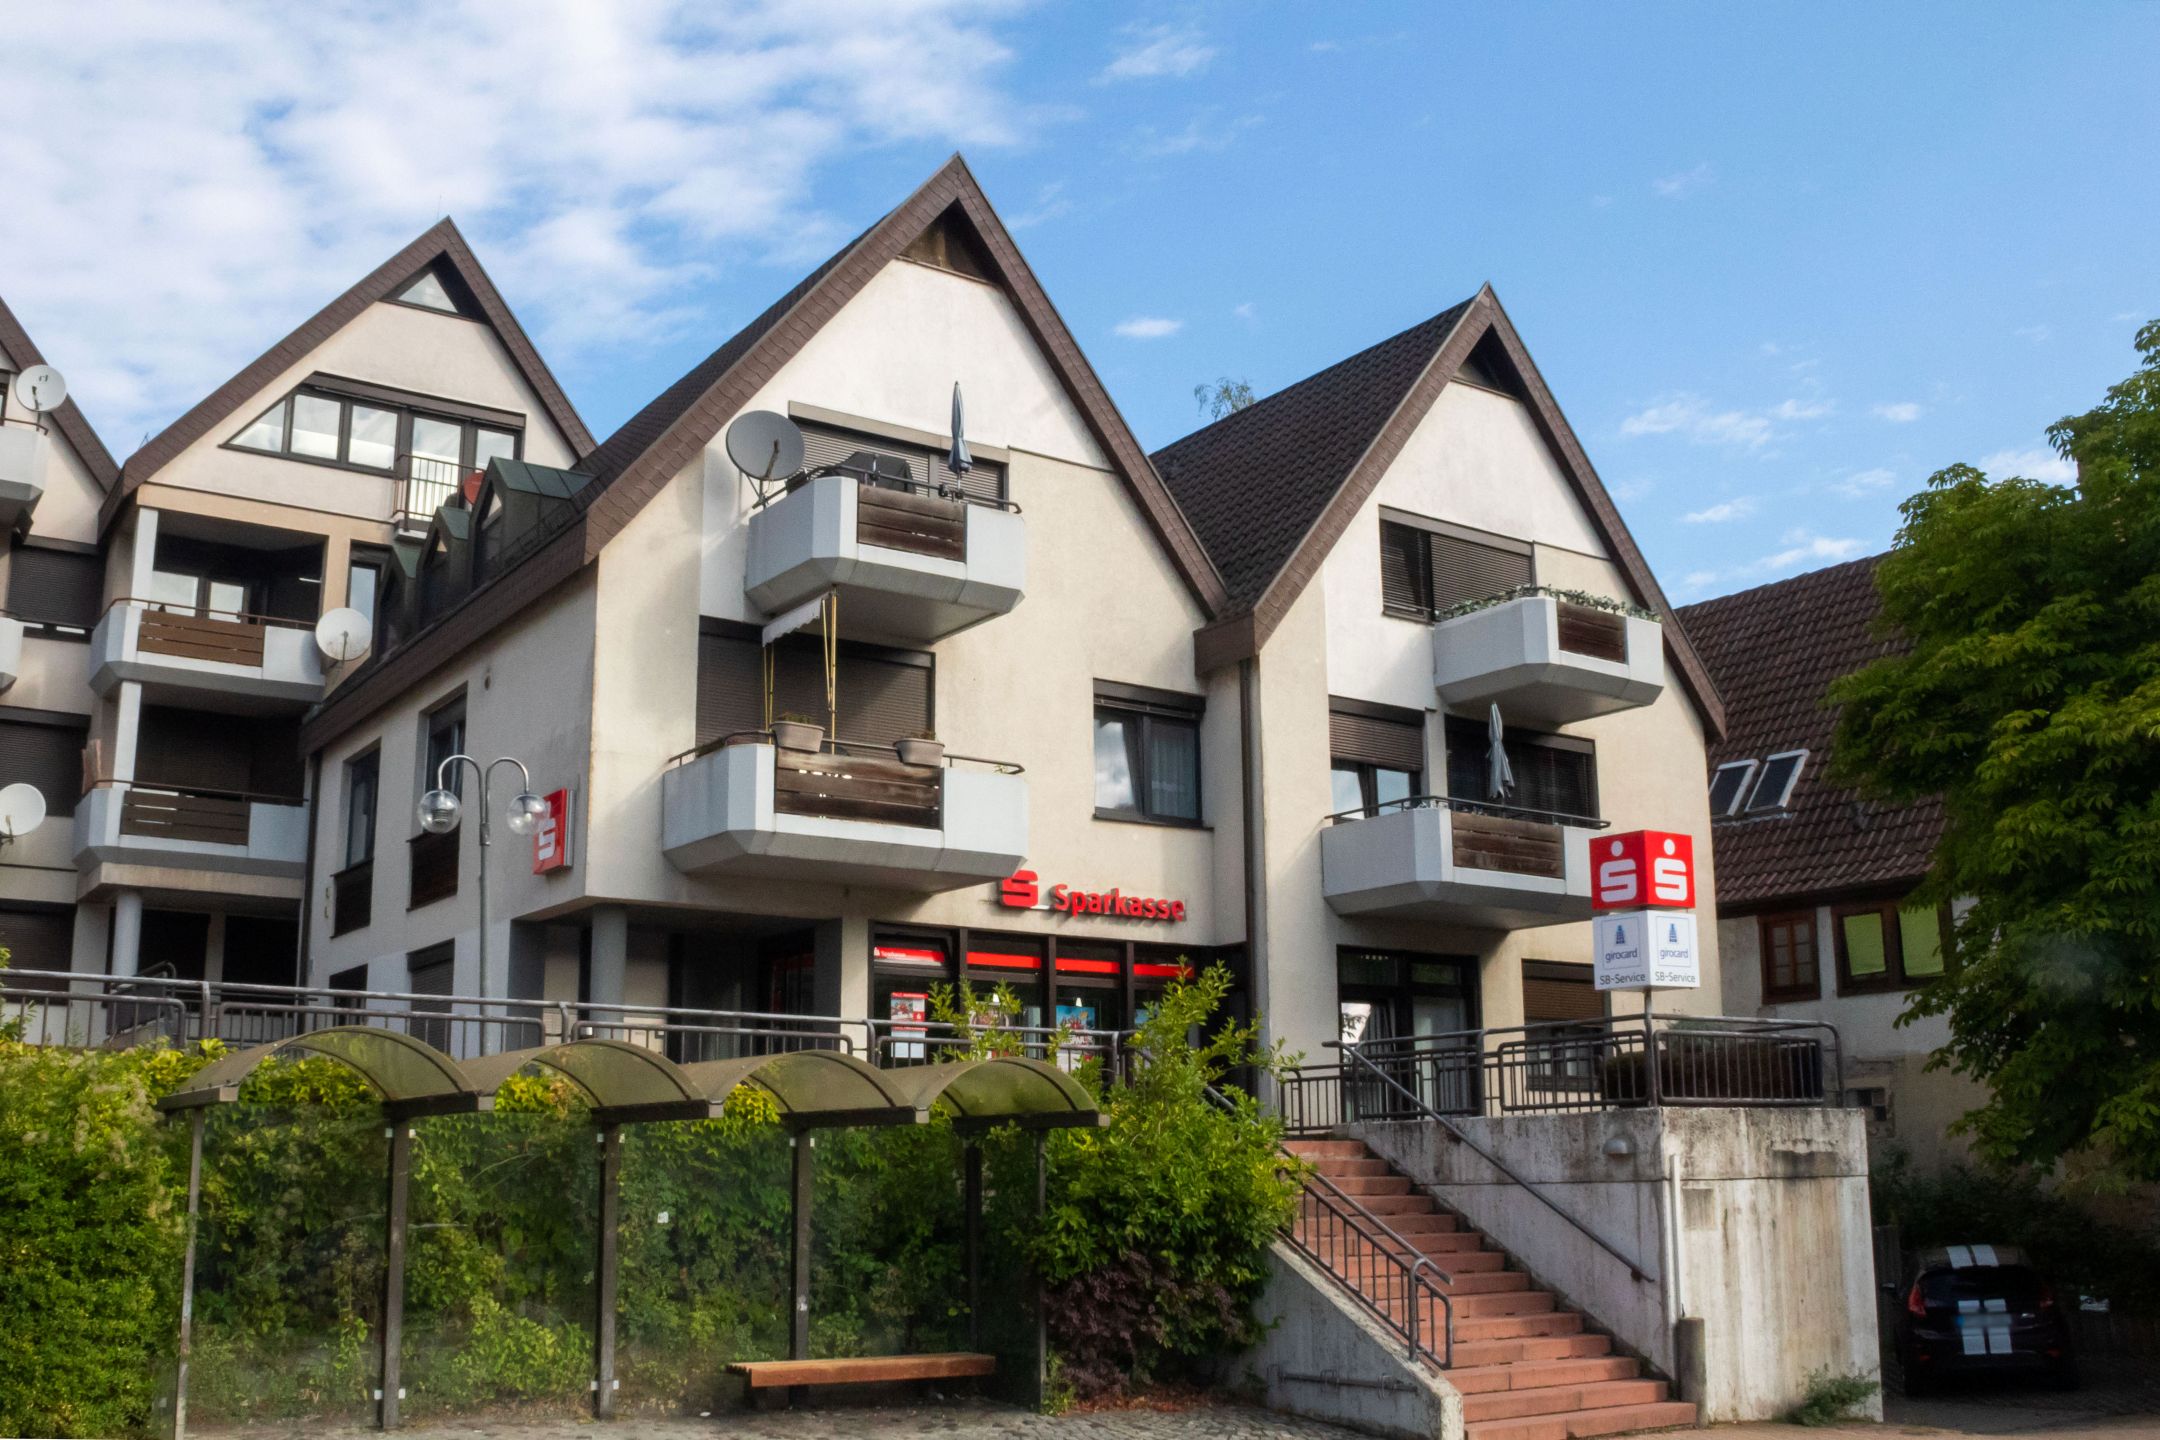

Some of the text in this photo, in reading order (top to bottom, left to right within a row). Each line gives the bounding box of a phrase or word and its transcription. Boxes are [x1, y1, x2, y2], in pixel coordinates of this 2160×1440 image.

[1053, 883, 1185, 921] Sparkasse
[1605, 947, 1638, 964] girocard
[1659, 948, 1689, 960] girocard
[1599, 973, 1646, 986] SB-Service
[1655, 971, 1696, 983] SB-Service
